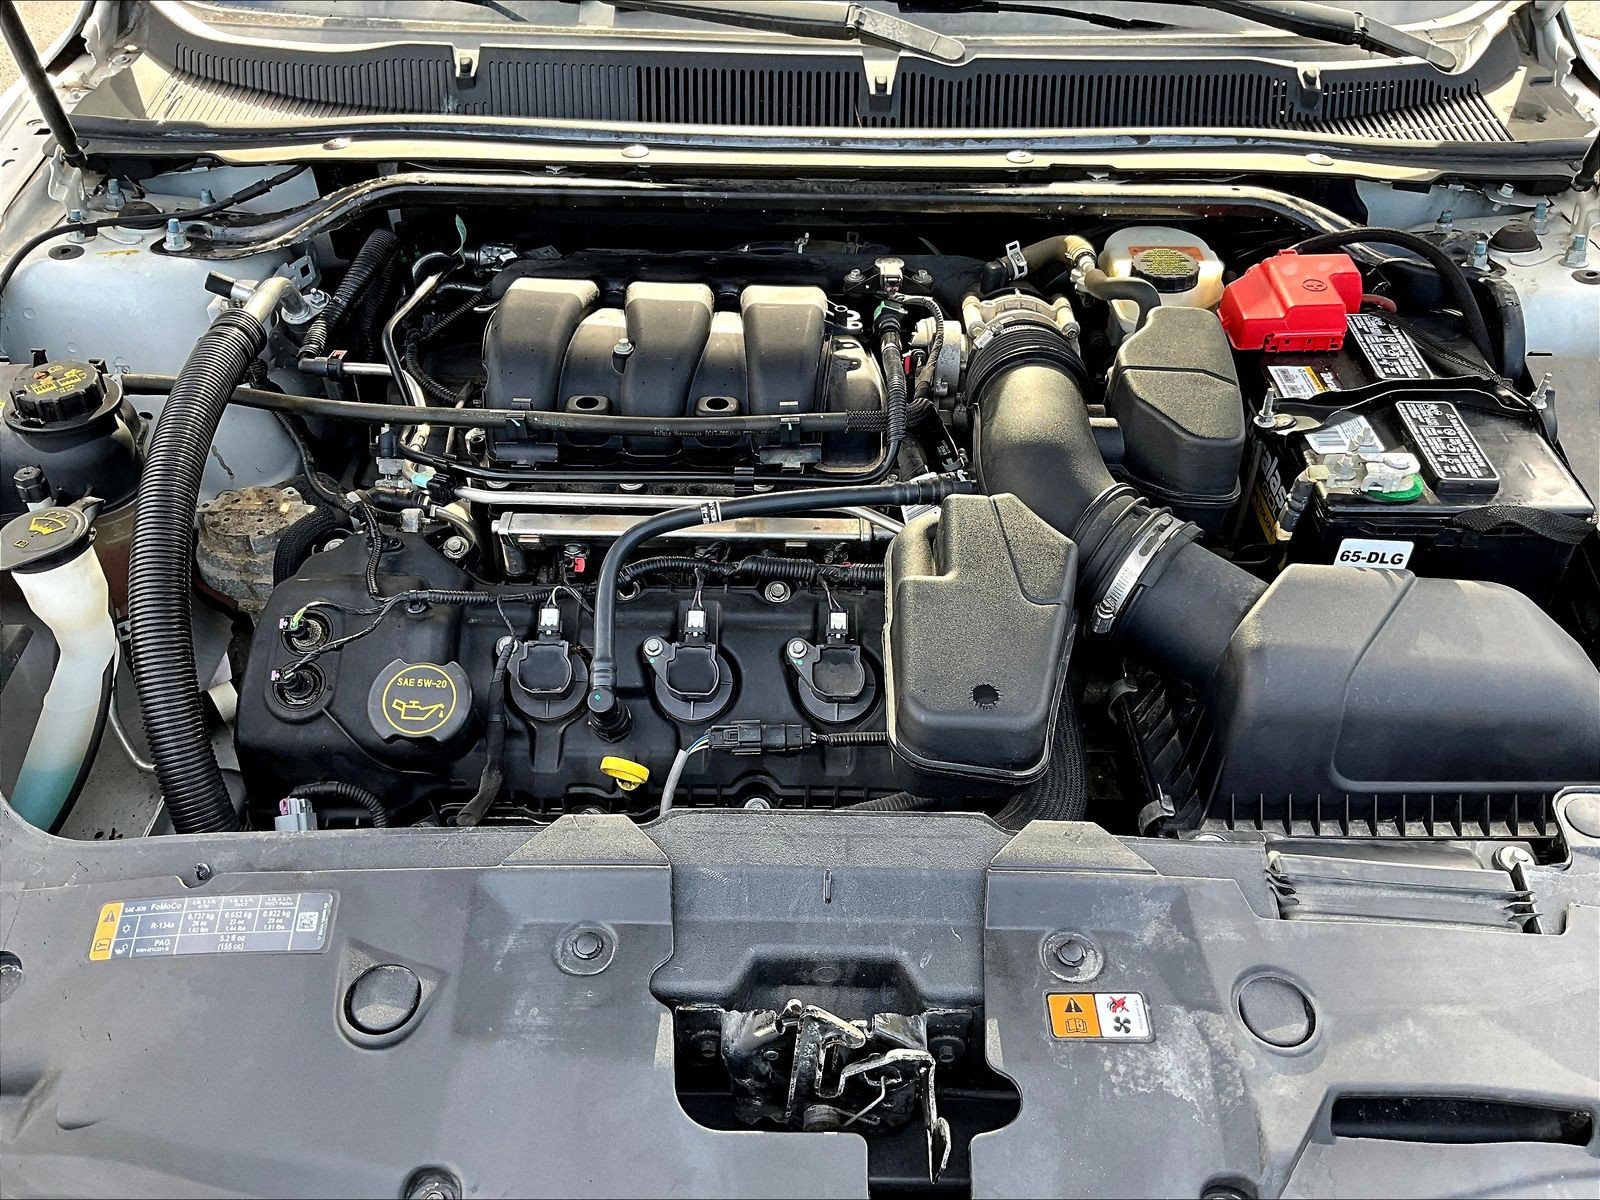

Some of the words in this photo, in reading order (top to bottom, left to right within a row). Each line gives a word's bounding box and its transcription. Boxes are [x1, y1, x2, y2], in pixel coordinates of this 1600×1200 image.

[1340, 550, 1404, 565] 65-DLG
[397, 678, 415, 687] SAE
[417, 679, 448, 688] 5W-20
[151, 903, 182, 911] FoMoCo
[206, 912, 215, 921] kg
[243, 911, 252, 919] kg
[282, 910, 291, 918] kg
[218, 943, 232, 951] (155
[233, 942, 244, 951] cc)
